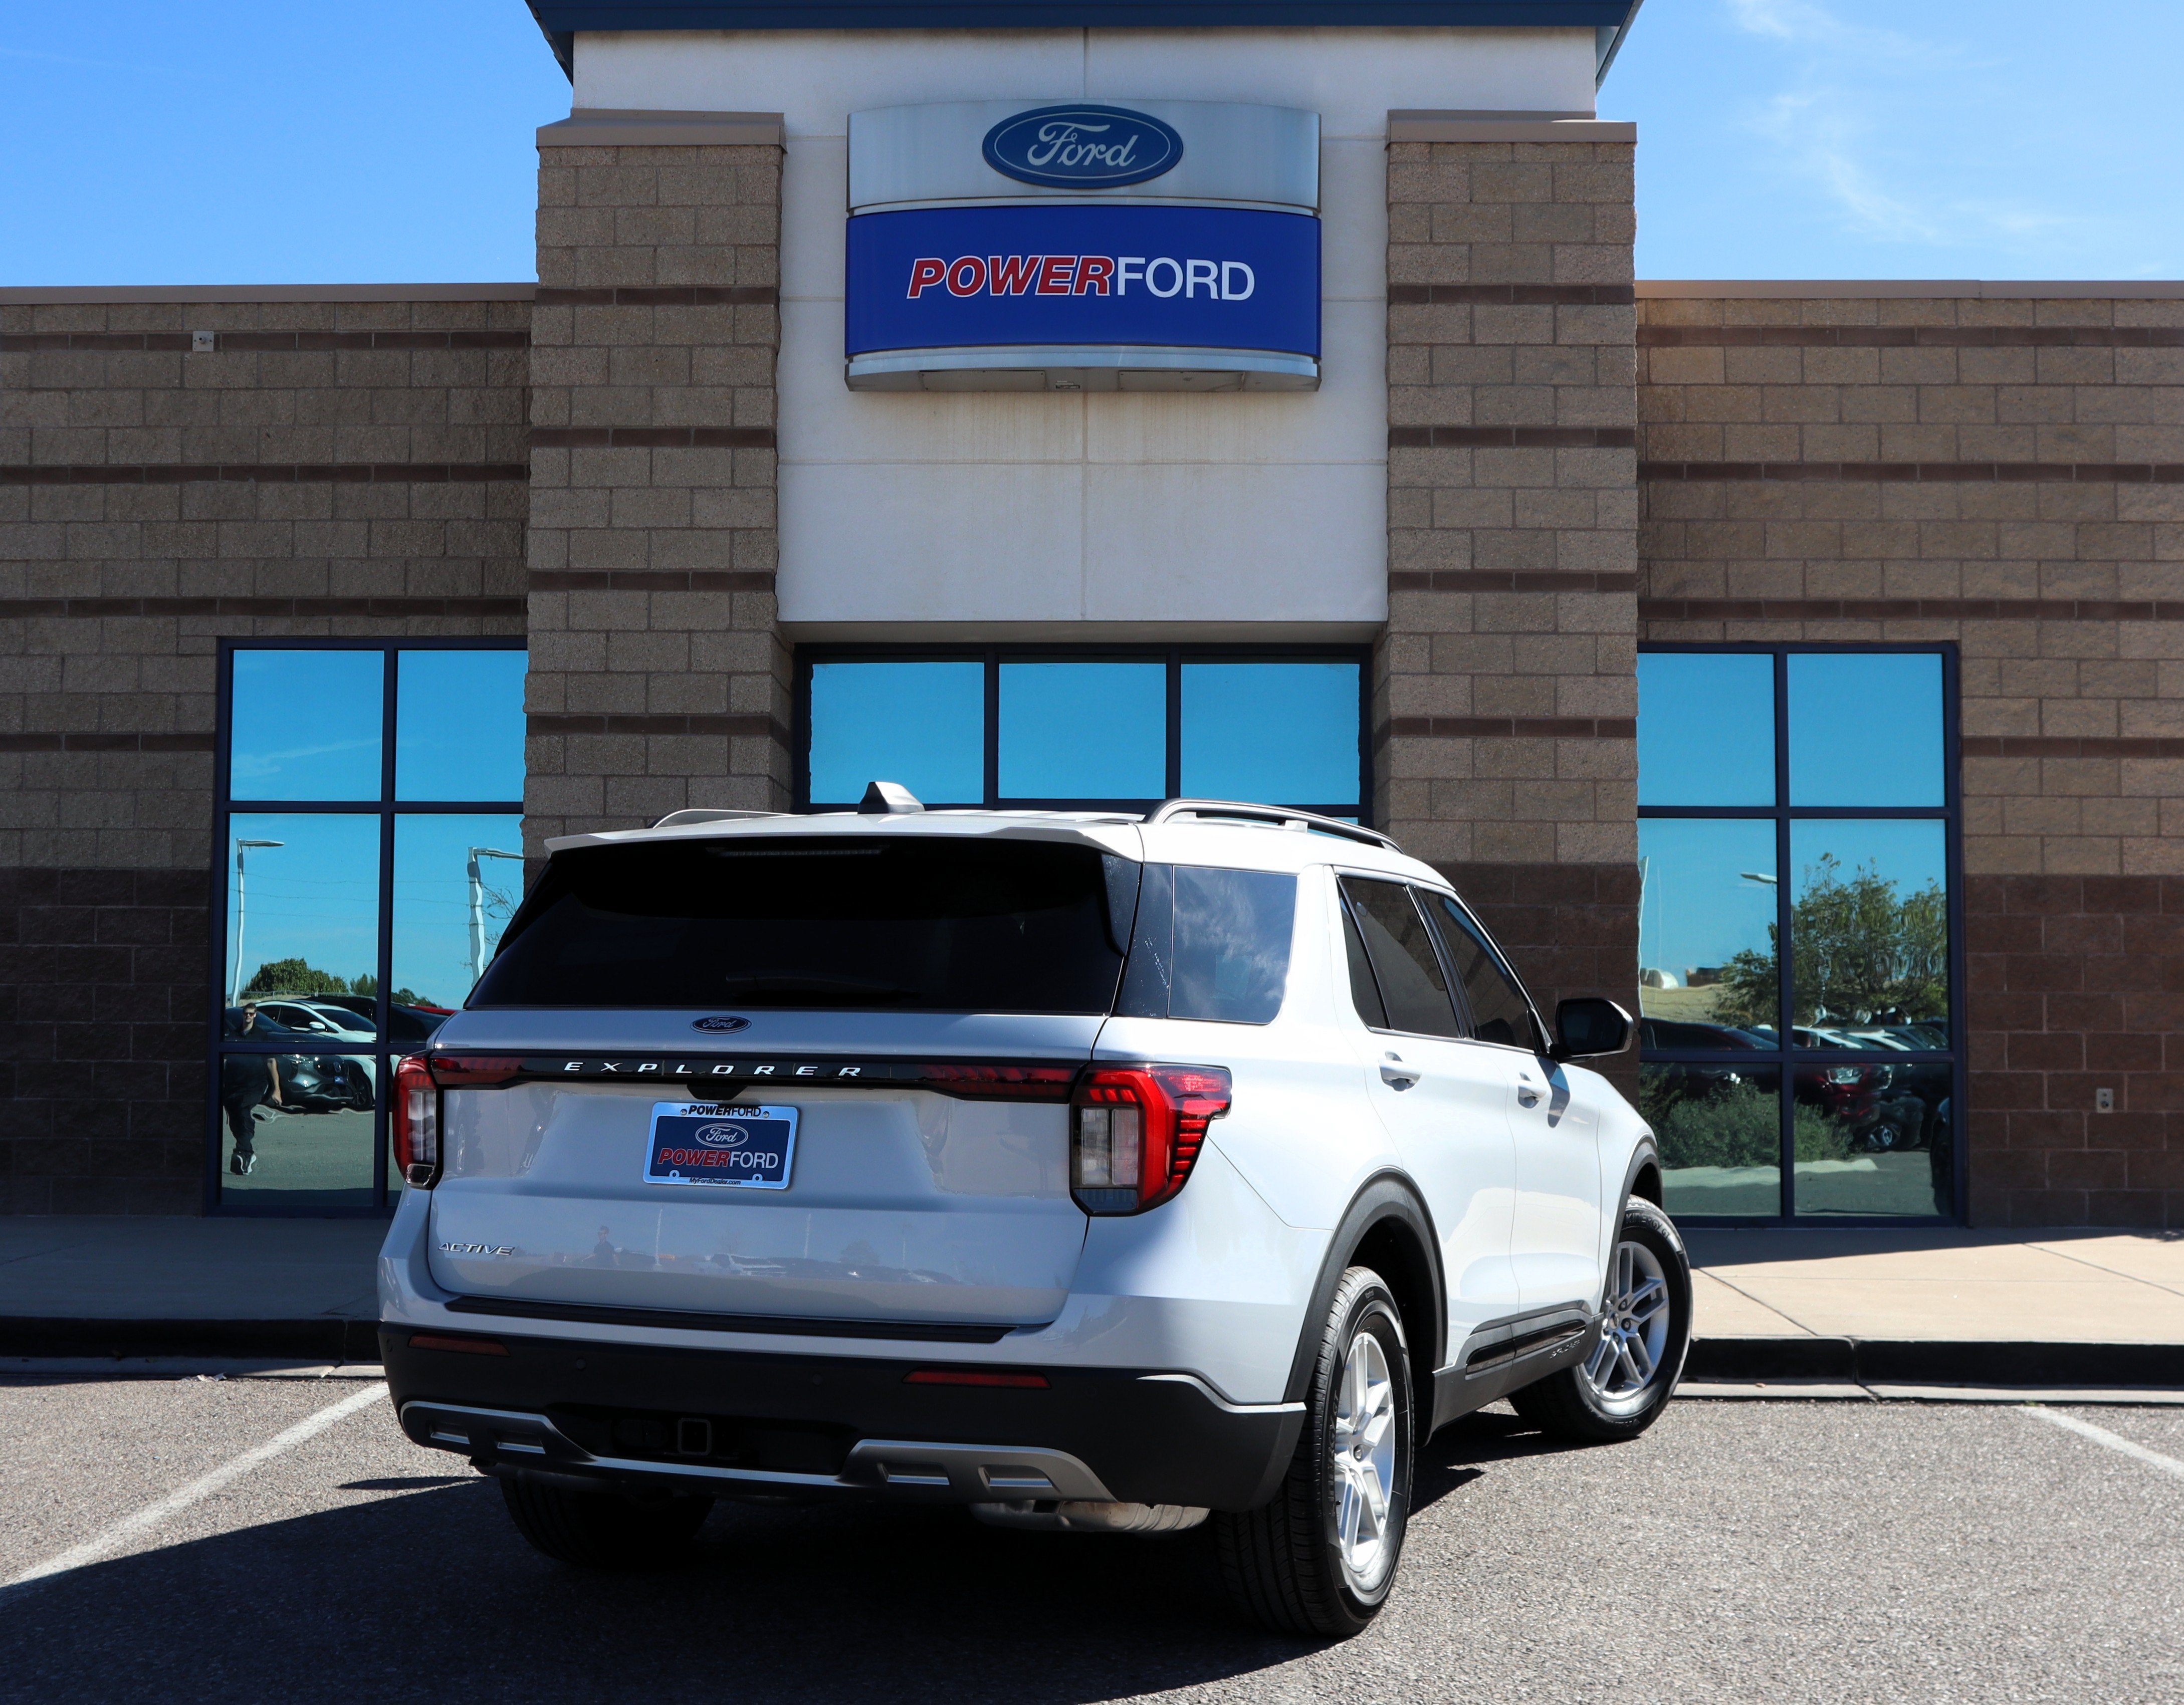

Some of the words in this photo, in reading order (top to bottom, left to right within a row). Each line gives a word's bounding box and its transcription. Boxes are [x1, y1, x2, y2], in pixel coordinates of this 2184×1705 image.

[1027, 121, 1138, 167] Ford
[907, 254, 1255, 301] POWERFORD
[703, 1017, 737, 1028] Ford
[564, 1061, 861, 1077] EXPLORER
[688, 1105, 762, 1118] POWERFORD
[706, 1127, 738, 1143] Ford
[657, 1147, 779, 1169] POWERFORD
[438, 1242, 515, 1256] ACTIVE
